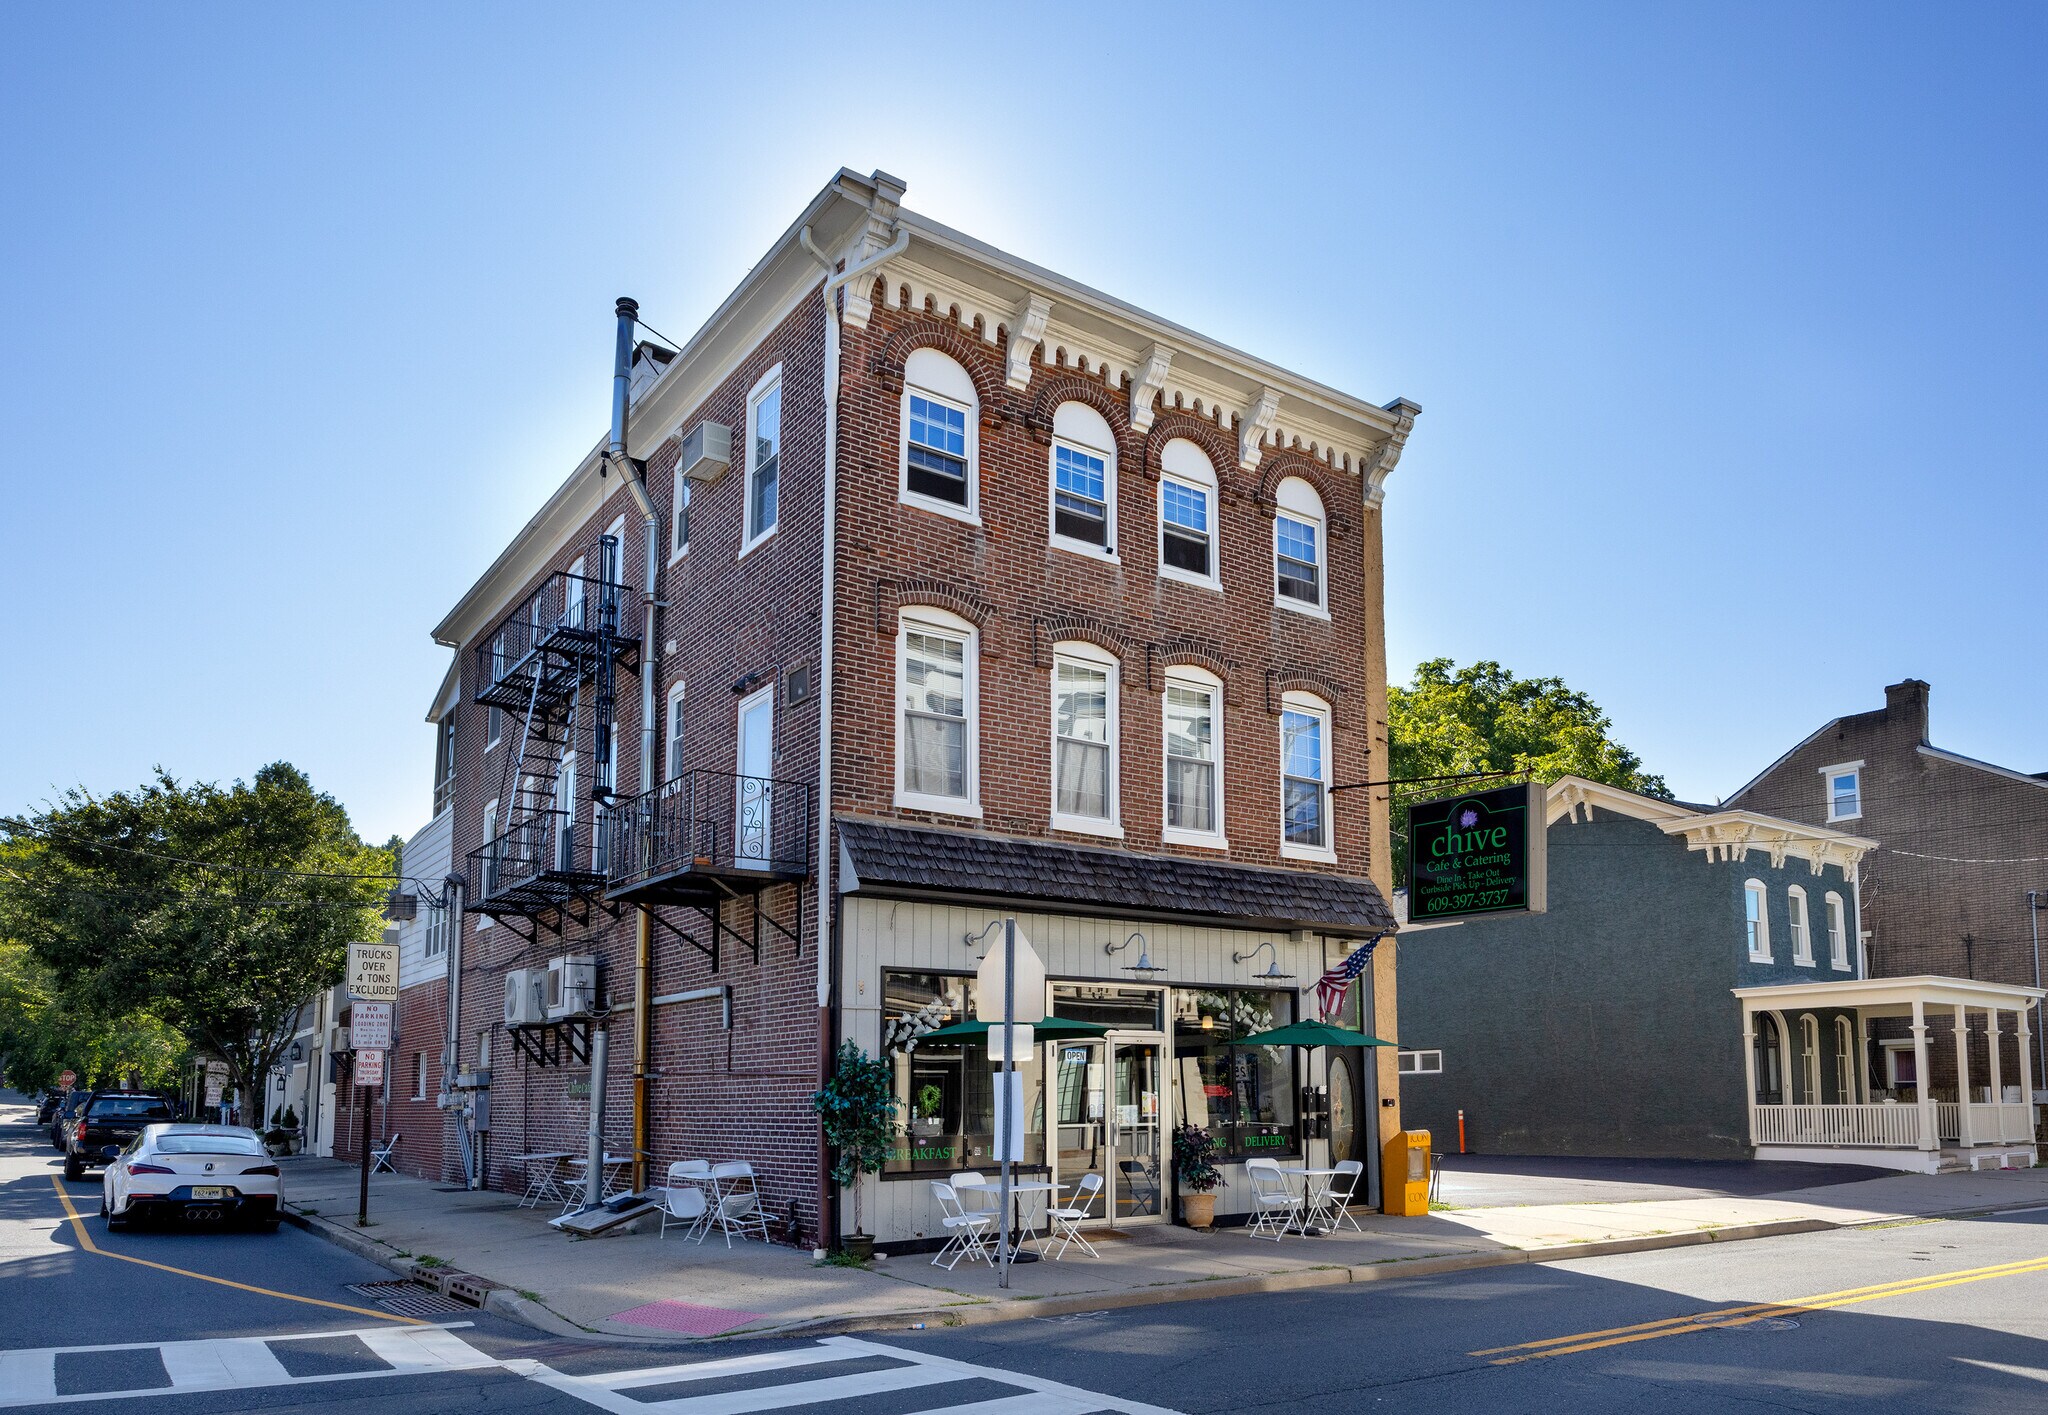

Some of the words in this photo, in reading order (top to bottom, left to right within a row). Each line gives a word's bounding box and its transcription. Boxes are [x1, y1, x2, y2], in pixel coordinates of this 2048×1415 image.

[1431, 825, 1507, 857] chive
[1426, 859, 1450, 873] Cafe
[1452, 858, 1462, 869] &
[1465, 852, 1511, 867] Catering
[1436, 875, 1452, 884] Dine
[1454, 874, 1461, 882] In
[1467, 871, 1485, 880] Take
[1485, 869, 1500, 878] Out
[1420, 884, 1452, 895] Curbside
[1452, 881, 1467, 891] Pick
[1469, 880, 1480, 890] Up
[1486, 876, 1516, 887] Delivery
[1427, 889, 1509, 912] 609-397-3737
[356, 949, 392, 960] TRUCKS
[362, 961, 386, 971] OVER
[356, 973, 363, 982] 4
[367, 973, 391, 983] TONS
[349, 985, 397, 995] EXCLUDED
[1066, 1051, 1085, 1060] OPEN
[1245, 1135, 1286, 1147] DELIVERY
